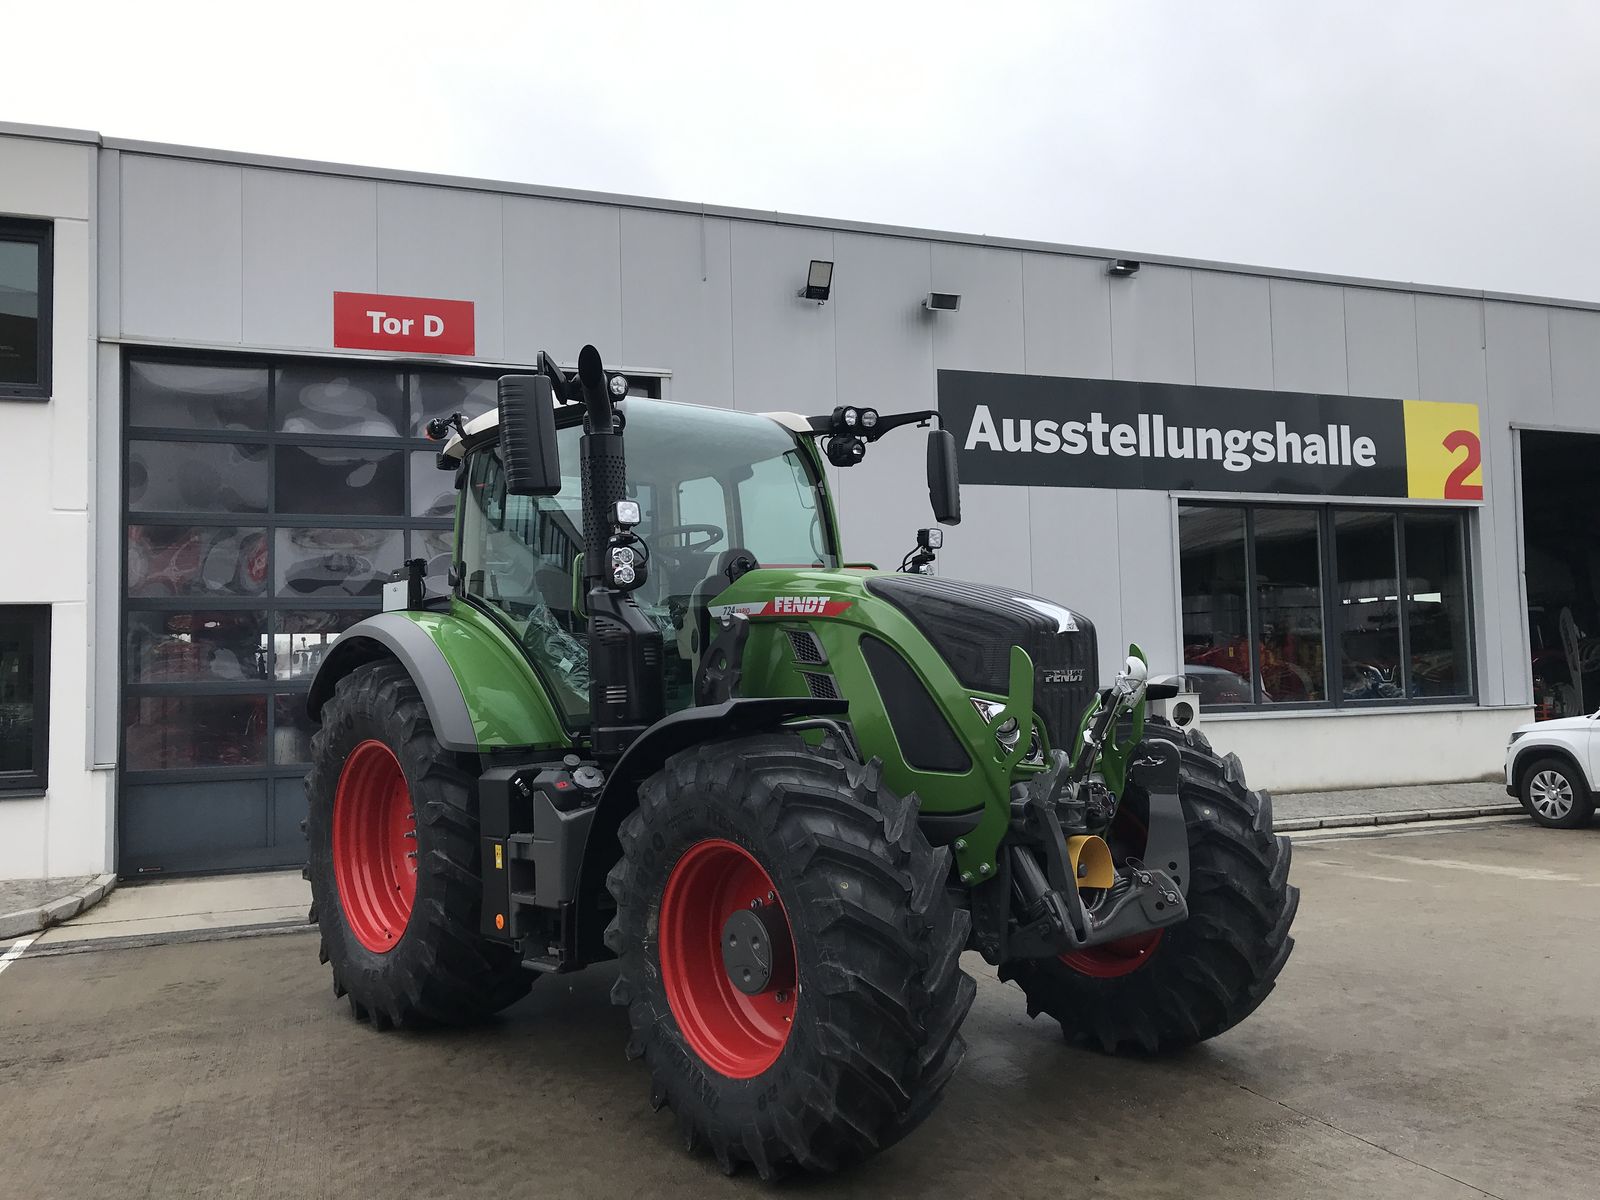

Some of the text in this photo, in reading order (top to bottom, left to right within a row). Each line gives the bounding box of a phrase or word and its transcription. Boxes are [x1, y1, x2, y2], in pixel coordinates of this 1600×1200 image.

[366, 310, 445, 337] Tor D
[964, 404, 1484, 500] Ausstellungshalle 2
[723, 605, 736, 616] 724
[774, 596, 830, 613] FENDT
[1043, 669, 1085, 682] FENDT
